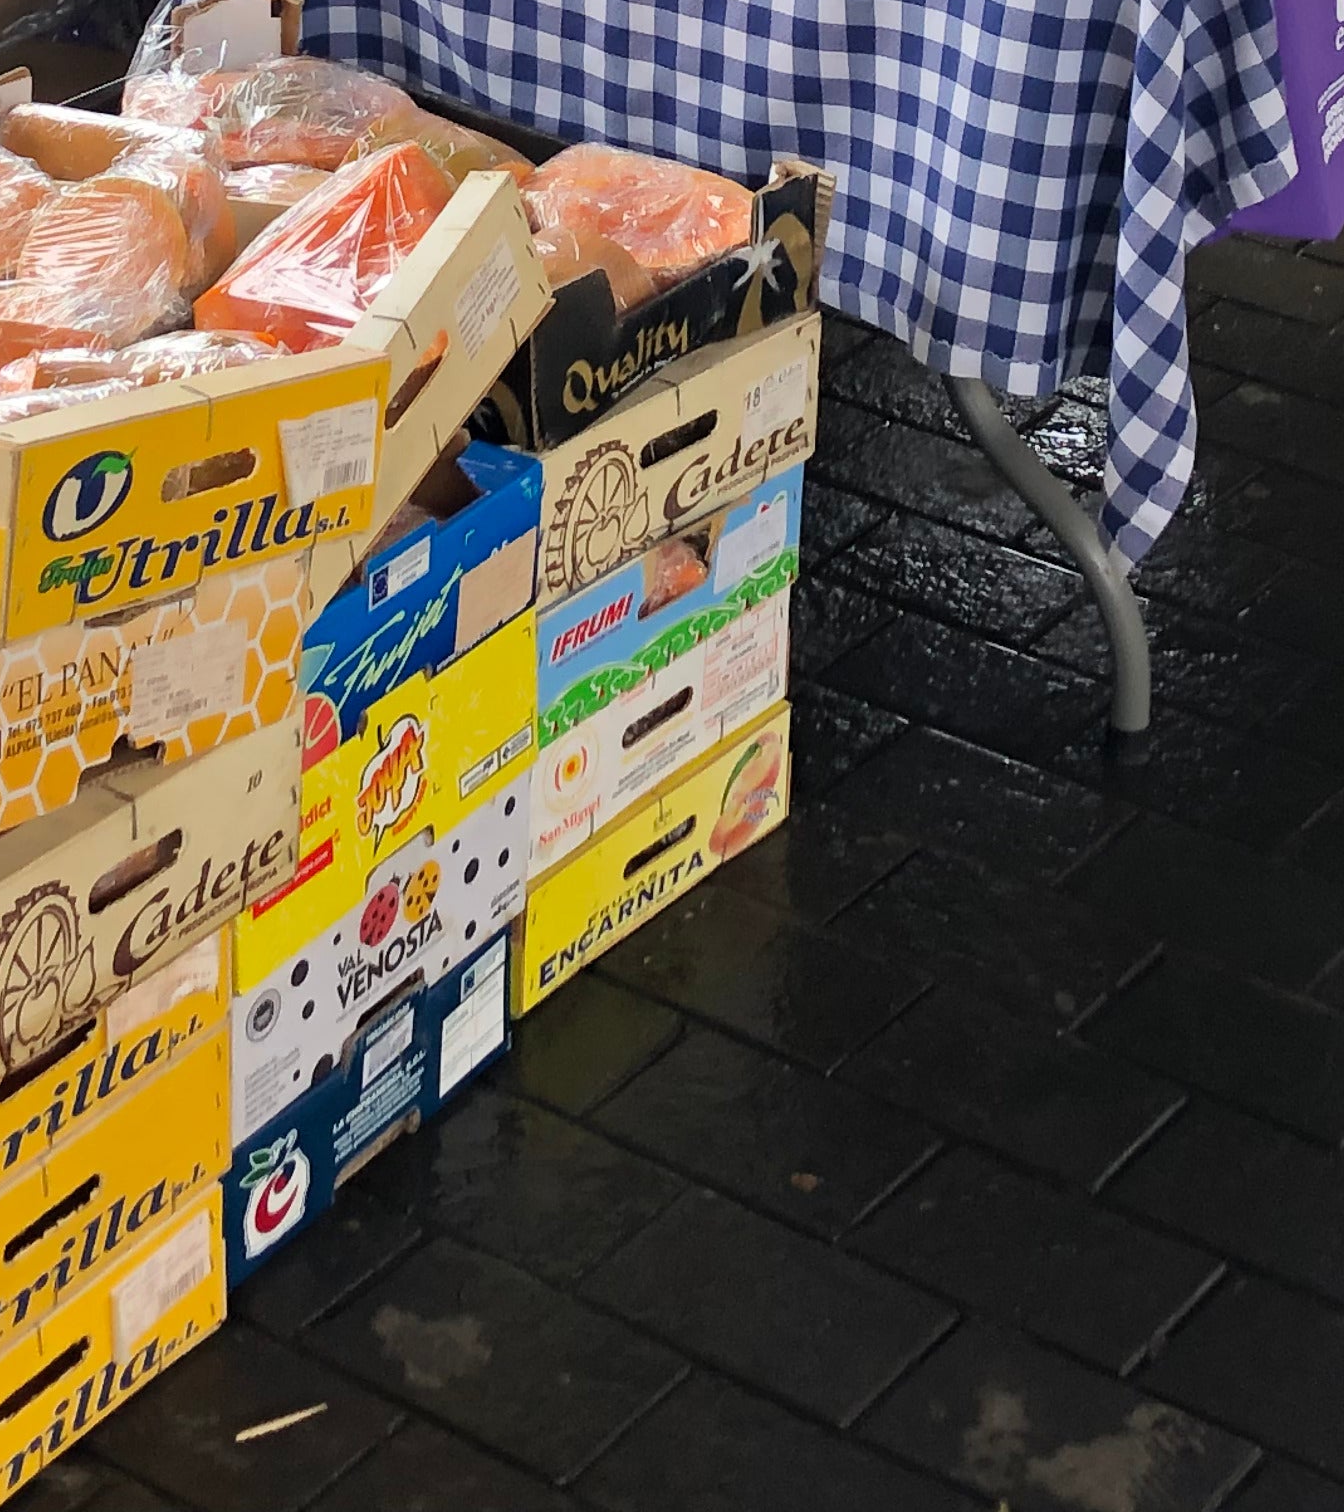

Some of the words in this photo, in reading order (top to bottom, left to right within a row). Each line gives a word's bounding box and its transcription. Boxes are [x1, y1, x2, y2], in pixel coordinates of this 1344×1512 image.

[562, 314, 690, 415] Quality
[663, 415, 806, 521] Cadete
[77, 493, 316, 605] Utrilla
[318, 506, 351, 535] s.l.
[550, 592, 634, 666] IFRUMI
[113, 830, 284, 977] Cadete
[540, 848, 703, 990] ENCARNITA
[337, 908, 443, 1010] VENOSTA
[338, 948, 364, 979] VAL
